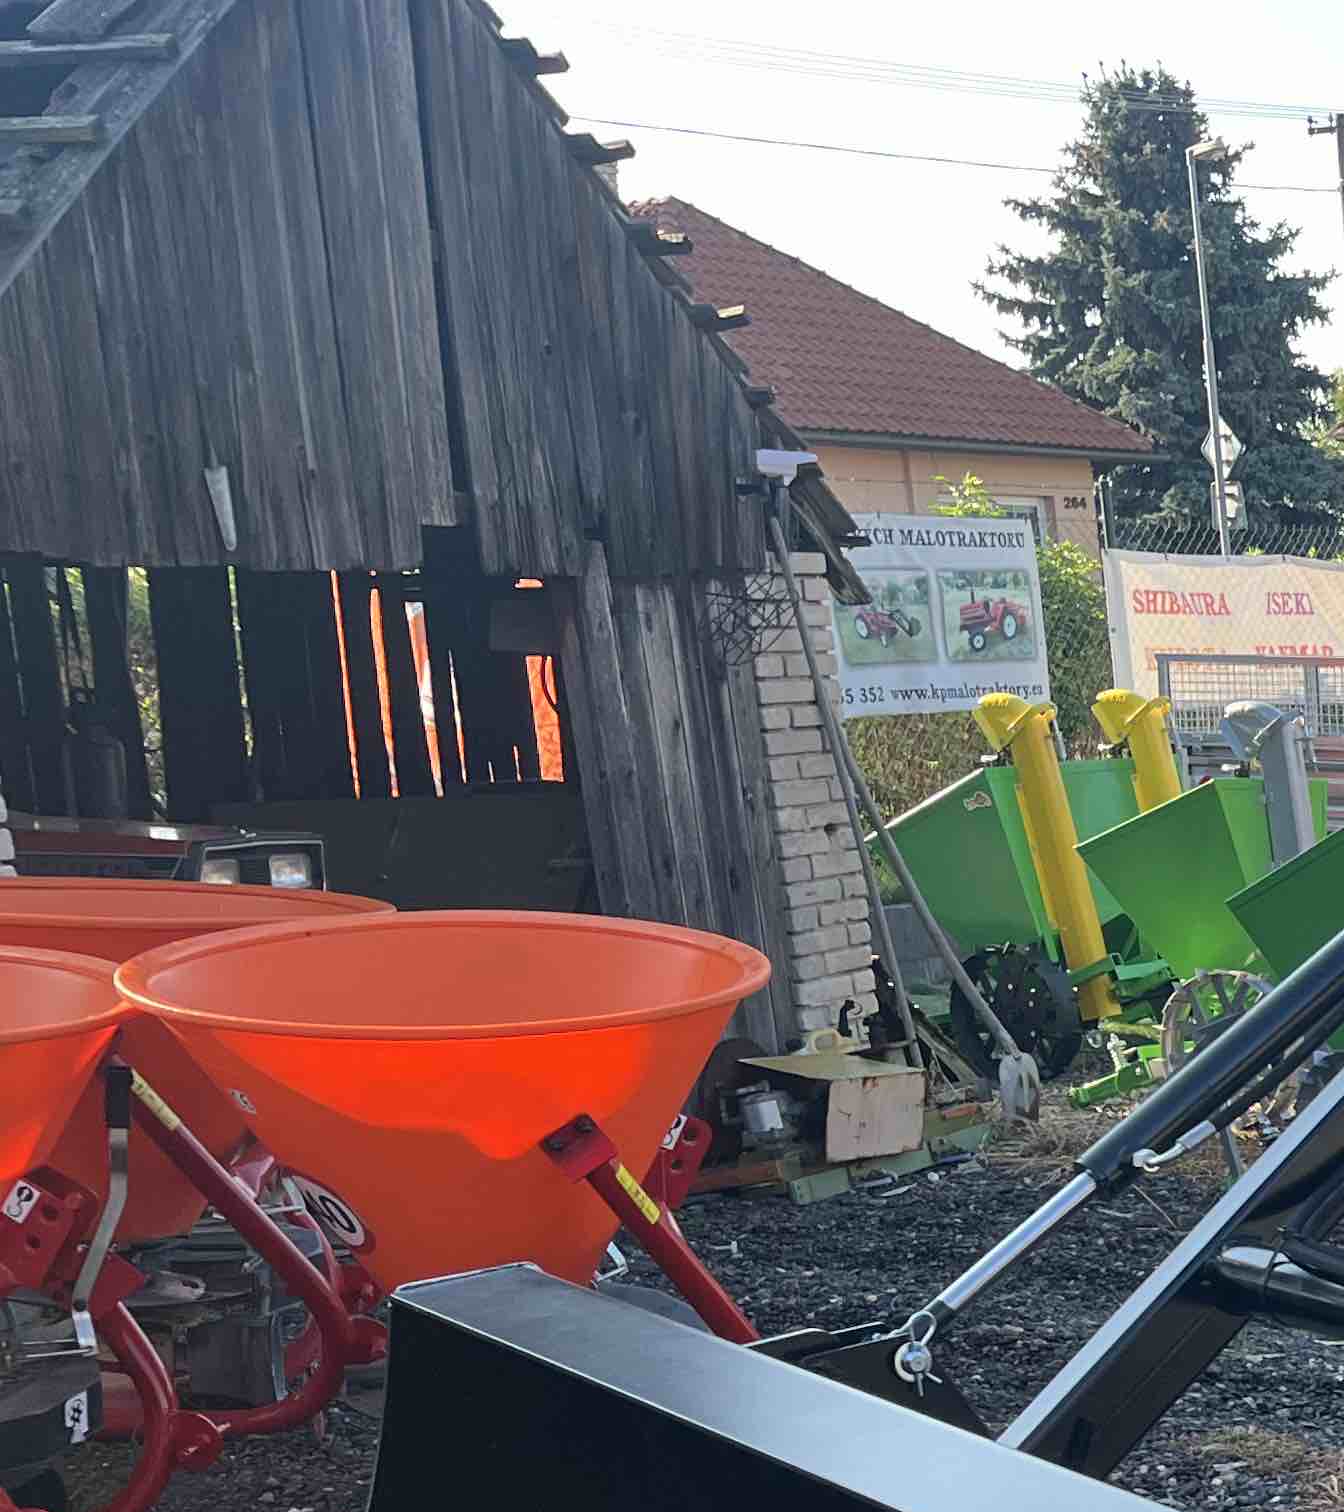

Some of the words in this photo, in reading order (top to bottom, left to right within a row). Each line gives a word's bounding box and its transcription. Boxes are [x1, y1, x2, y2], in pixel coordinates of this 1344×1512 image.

[1063, 496, 1087, 510] 264
[1132, 589, 1232, 616] SHIBAURA
[1265, 591, 1315, 616] ISEKI
[860, 686, 884, 703] 352
